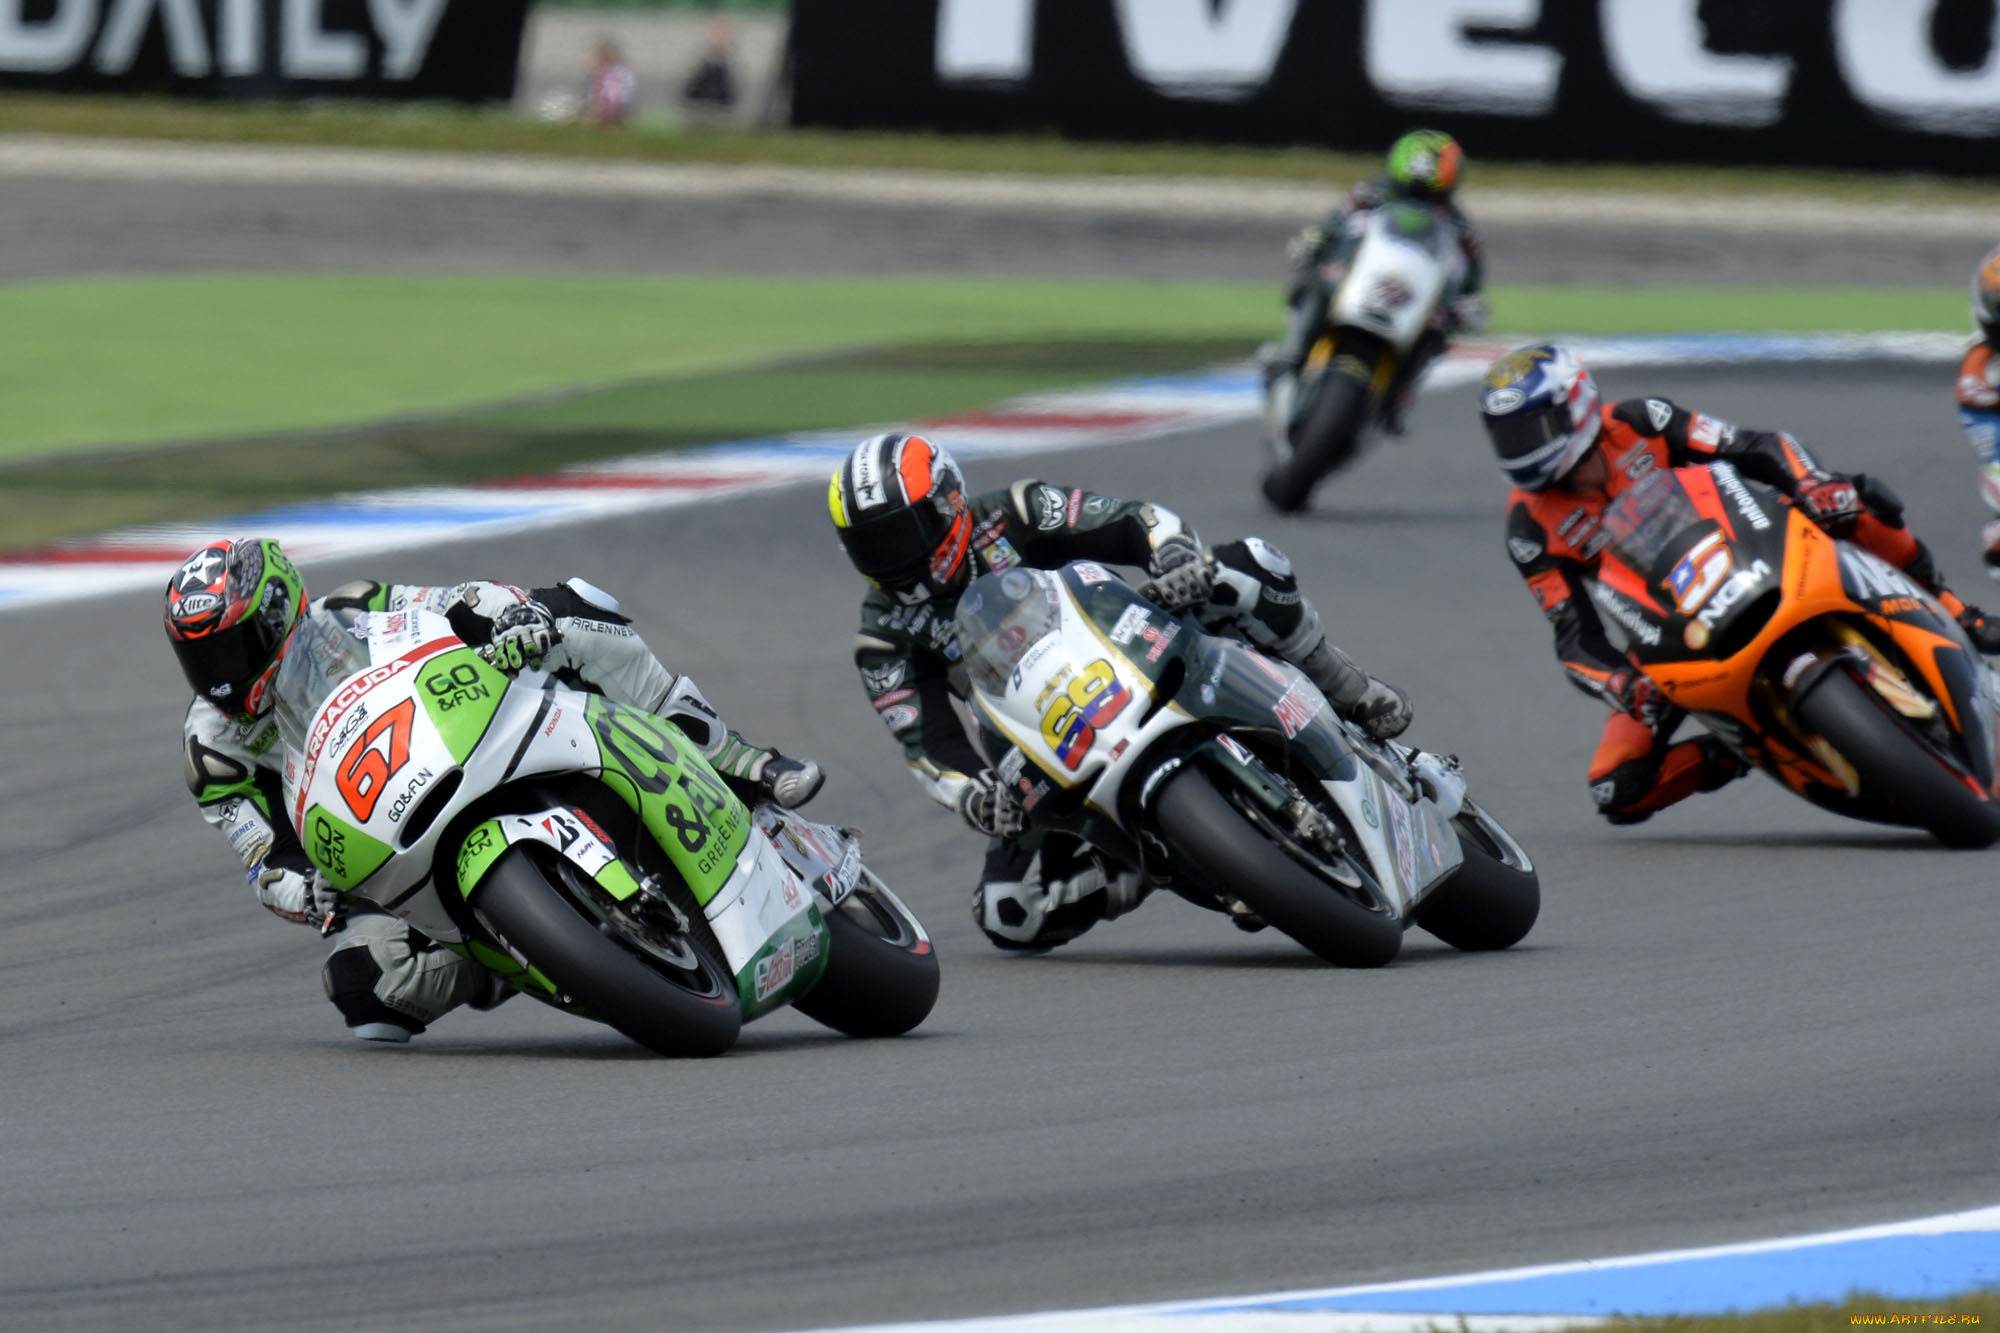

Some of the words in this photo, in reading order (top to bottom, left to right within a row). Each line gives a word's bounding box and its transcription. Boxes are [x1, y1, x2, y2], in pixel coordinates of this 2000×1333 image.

[1697, 558, 1771, 629] NGM
[425, 663, 480, 696] GO
[437, 684, 491, 712] &FUN
[301, 659, 411, 793] BARRACUDA
[544, 708, 563, 737] HONDA
[1040, 659, 1132, 771] 68
[335, 696, 416, 824] 67
[388, 767, 434, 822] GO&FUN
[315, 816, 332, 868] GO
